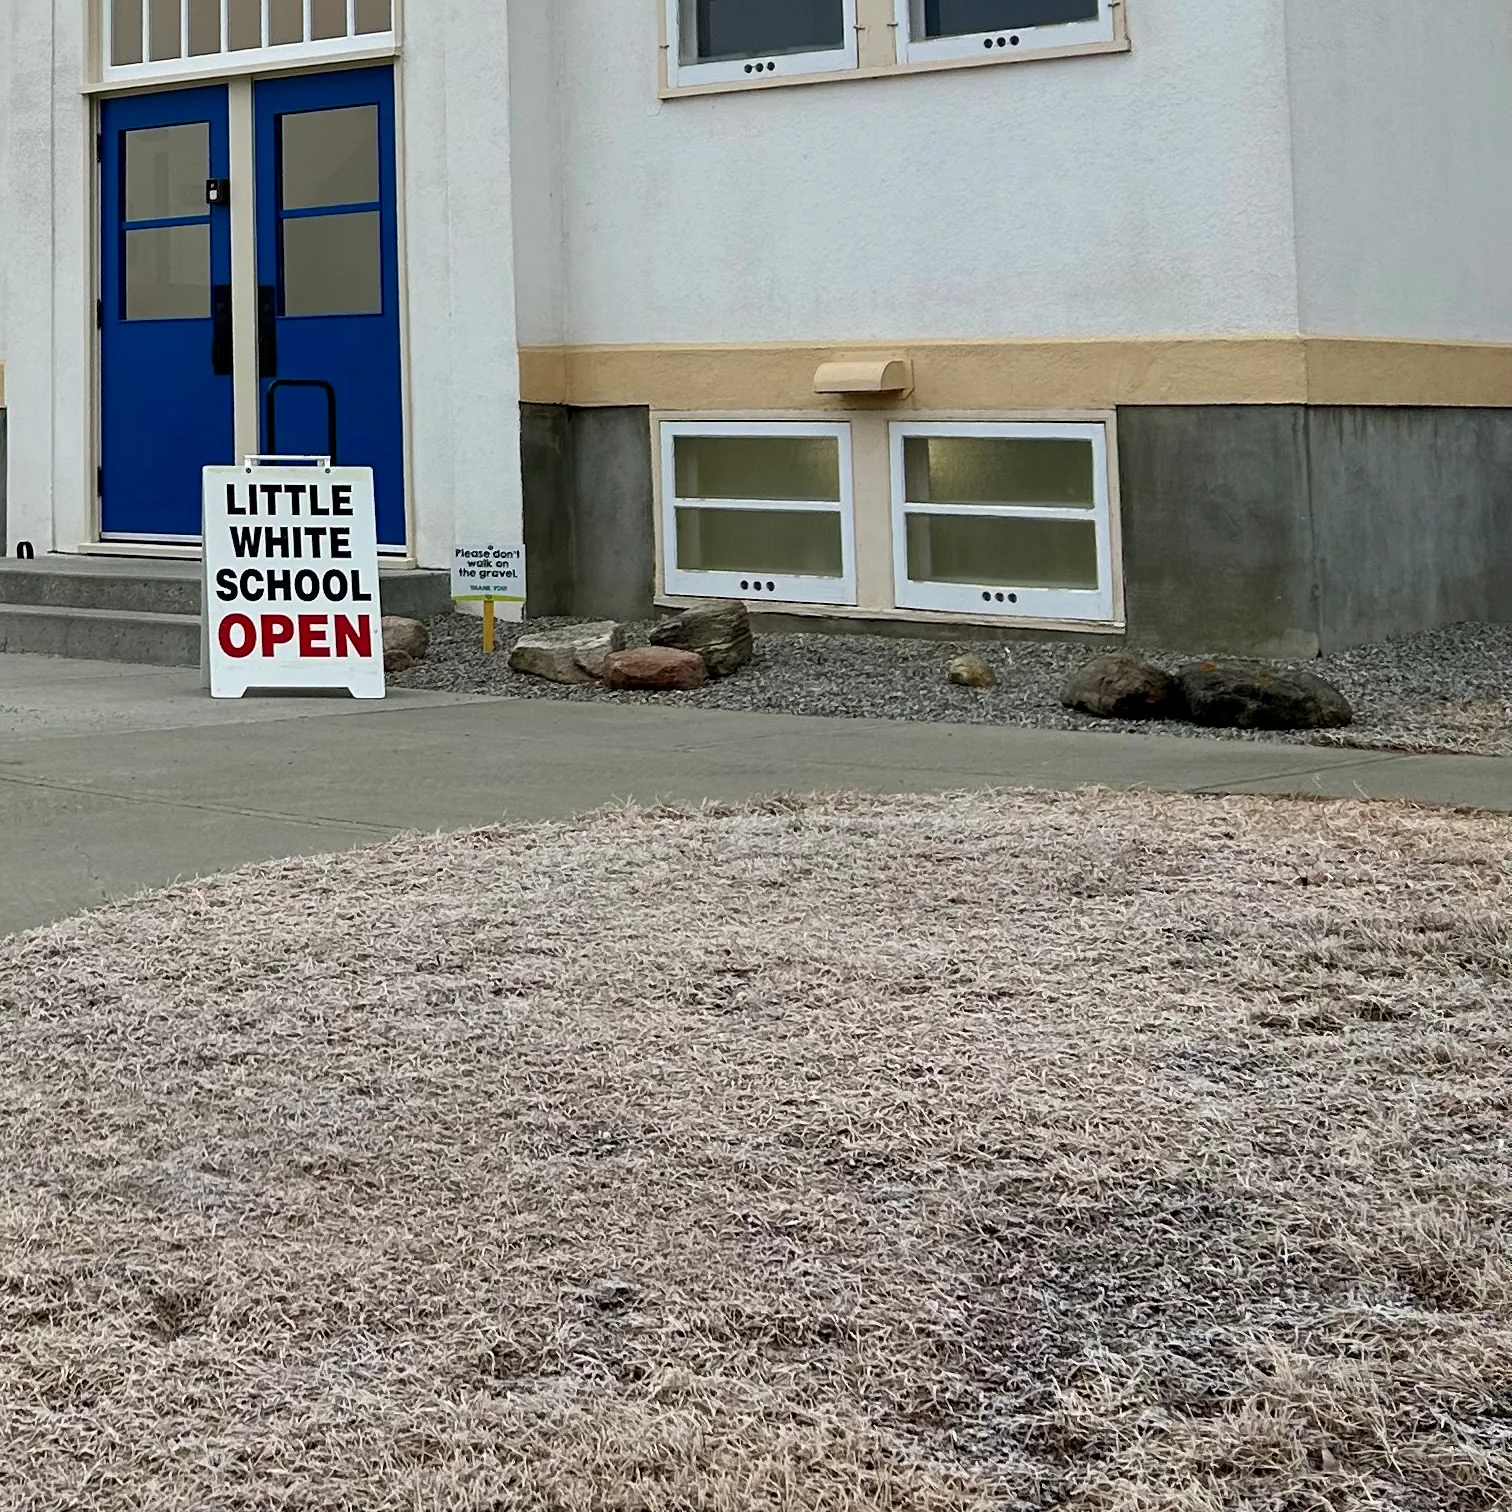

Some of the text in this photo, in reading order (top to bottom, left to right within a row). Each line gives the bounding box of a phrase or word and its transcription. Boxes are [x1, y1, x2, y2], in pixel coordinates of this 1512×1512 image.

[226, 483, 354, 516] LITTLE
[229, 526, 352, 559] WHITE
[455, 548, 520, 559] Please don't
[458, 567, 476, 577] the
[467, 559, 509, 568] walk on
[216, 568, 372, 602] SCHOOL
[218, 613, 372, 658] OPEN
